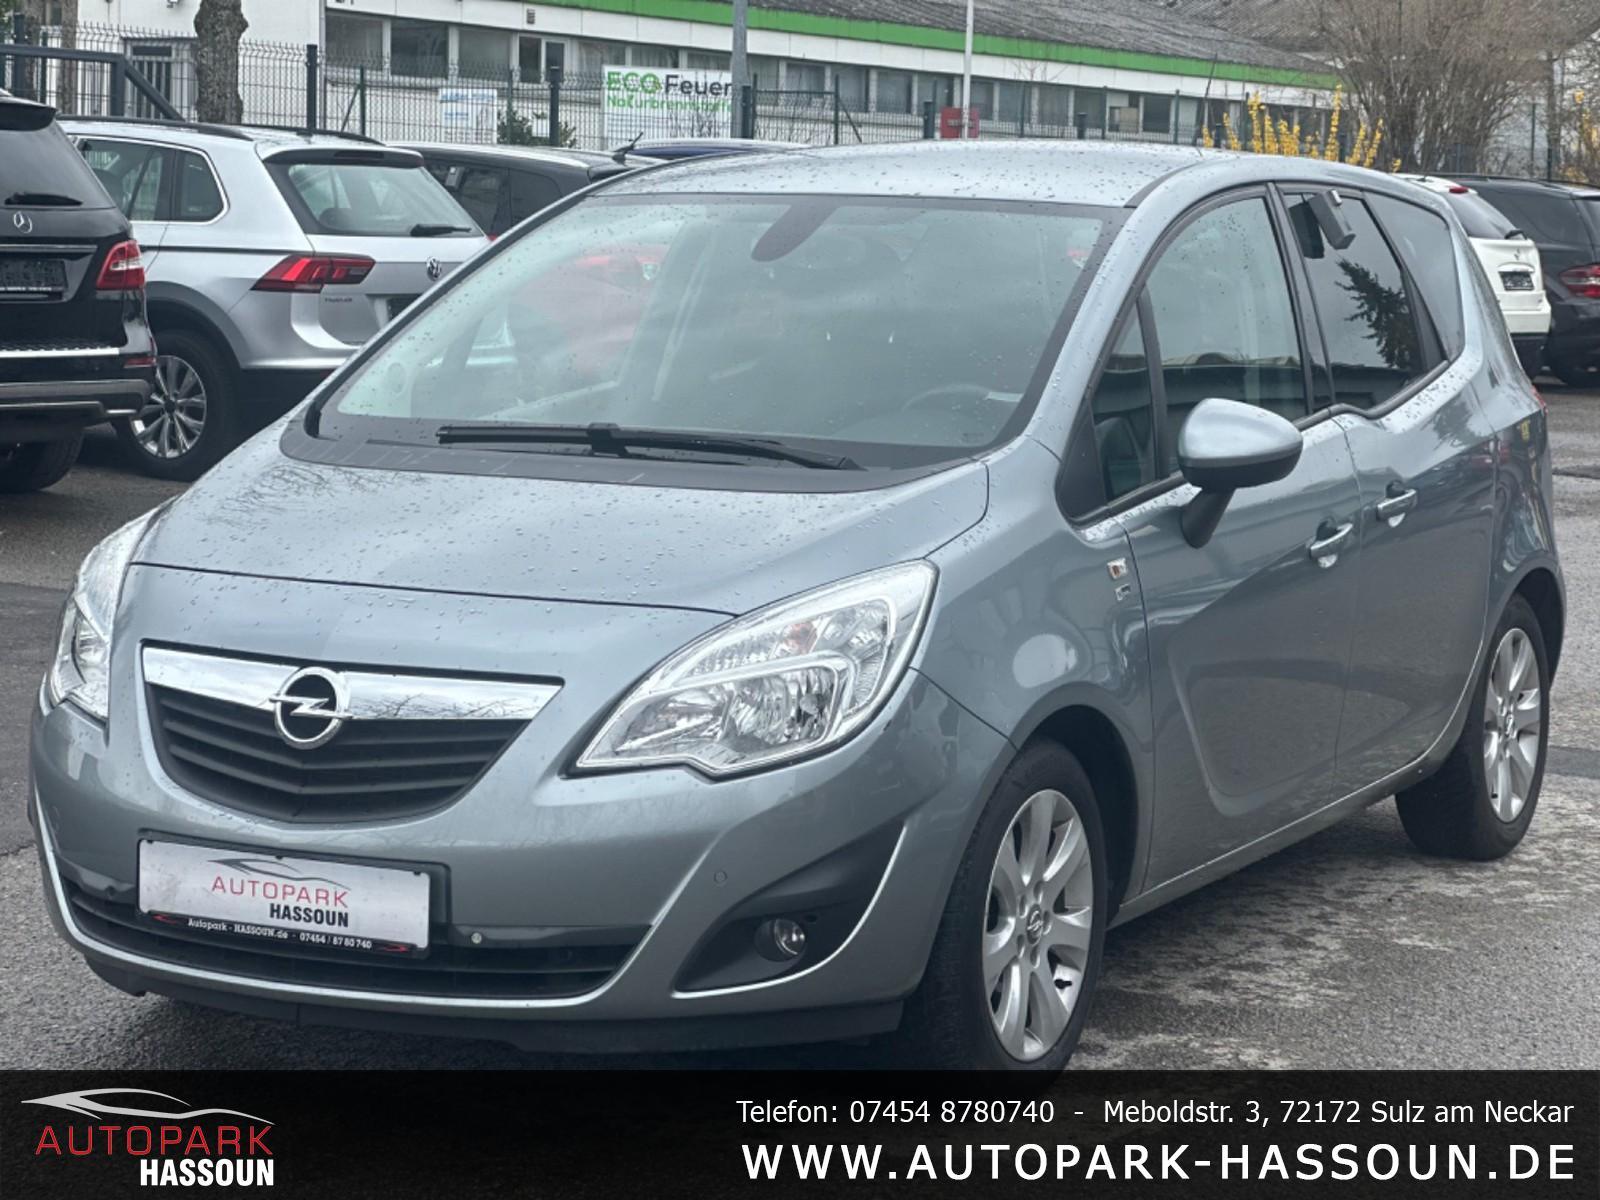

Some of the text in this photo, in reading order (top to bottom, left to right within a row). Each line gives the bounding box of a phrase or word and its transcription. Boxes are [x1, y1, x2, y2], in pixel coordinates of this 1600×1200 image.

[665, 74, 732, 96] Feuer
[211, 876, 348, 908] AUTOPARK
[188, 918, 228, 931] Autopark
[270, 903, 349, 928] HASSOUN
